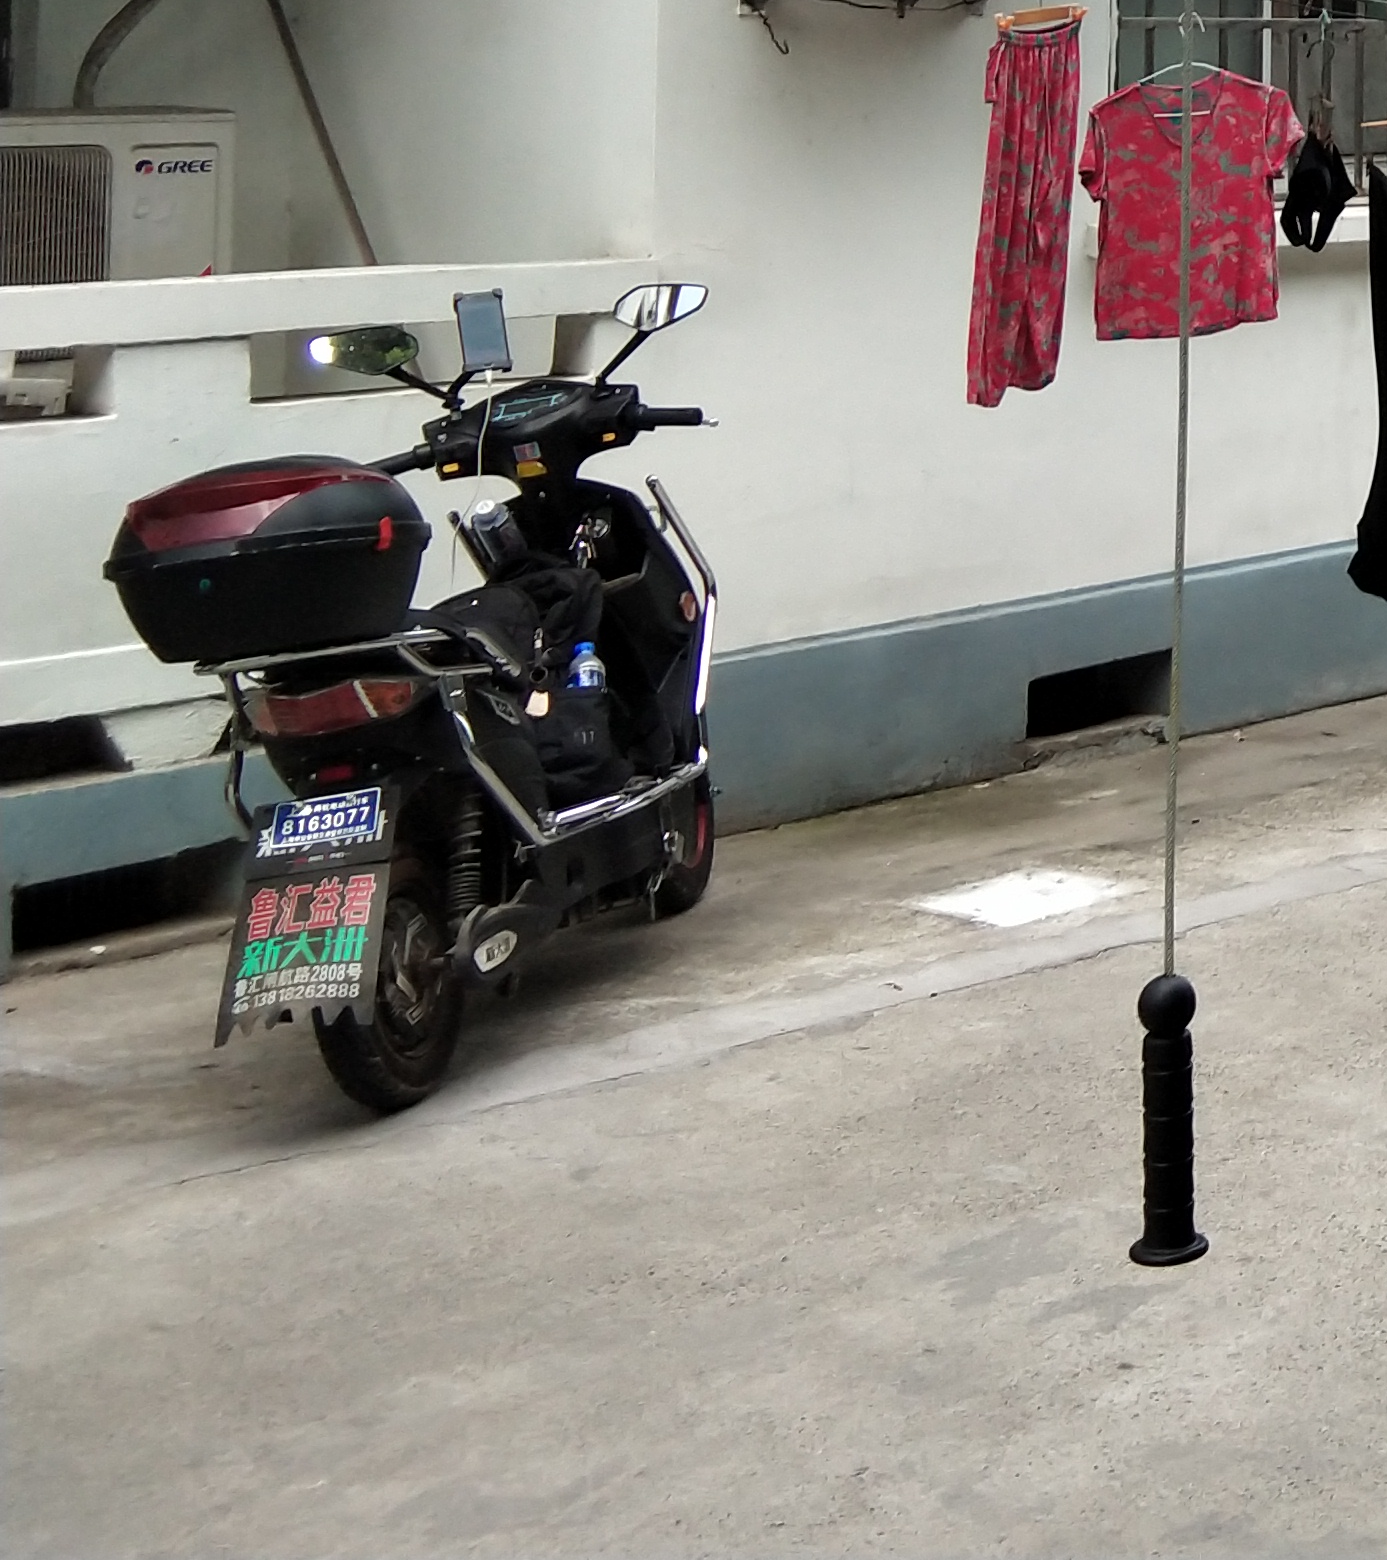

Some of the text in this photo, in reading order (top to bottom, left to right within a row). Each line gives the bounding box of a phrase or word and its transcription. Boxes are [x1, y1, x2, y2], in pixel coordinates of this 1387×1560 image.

[157, 159, 213, 174] GREE
[281, 806, 371, 836] 8163077
[247, 873, 377, 943] 鲁汇益君
[236, 926, 369, 980] 新大洲
[253, 983, 361, 1008] 13818262888
